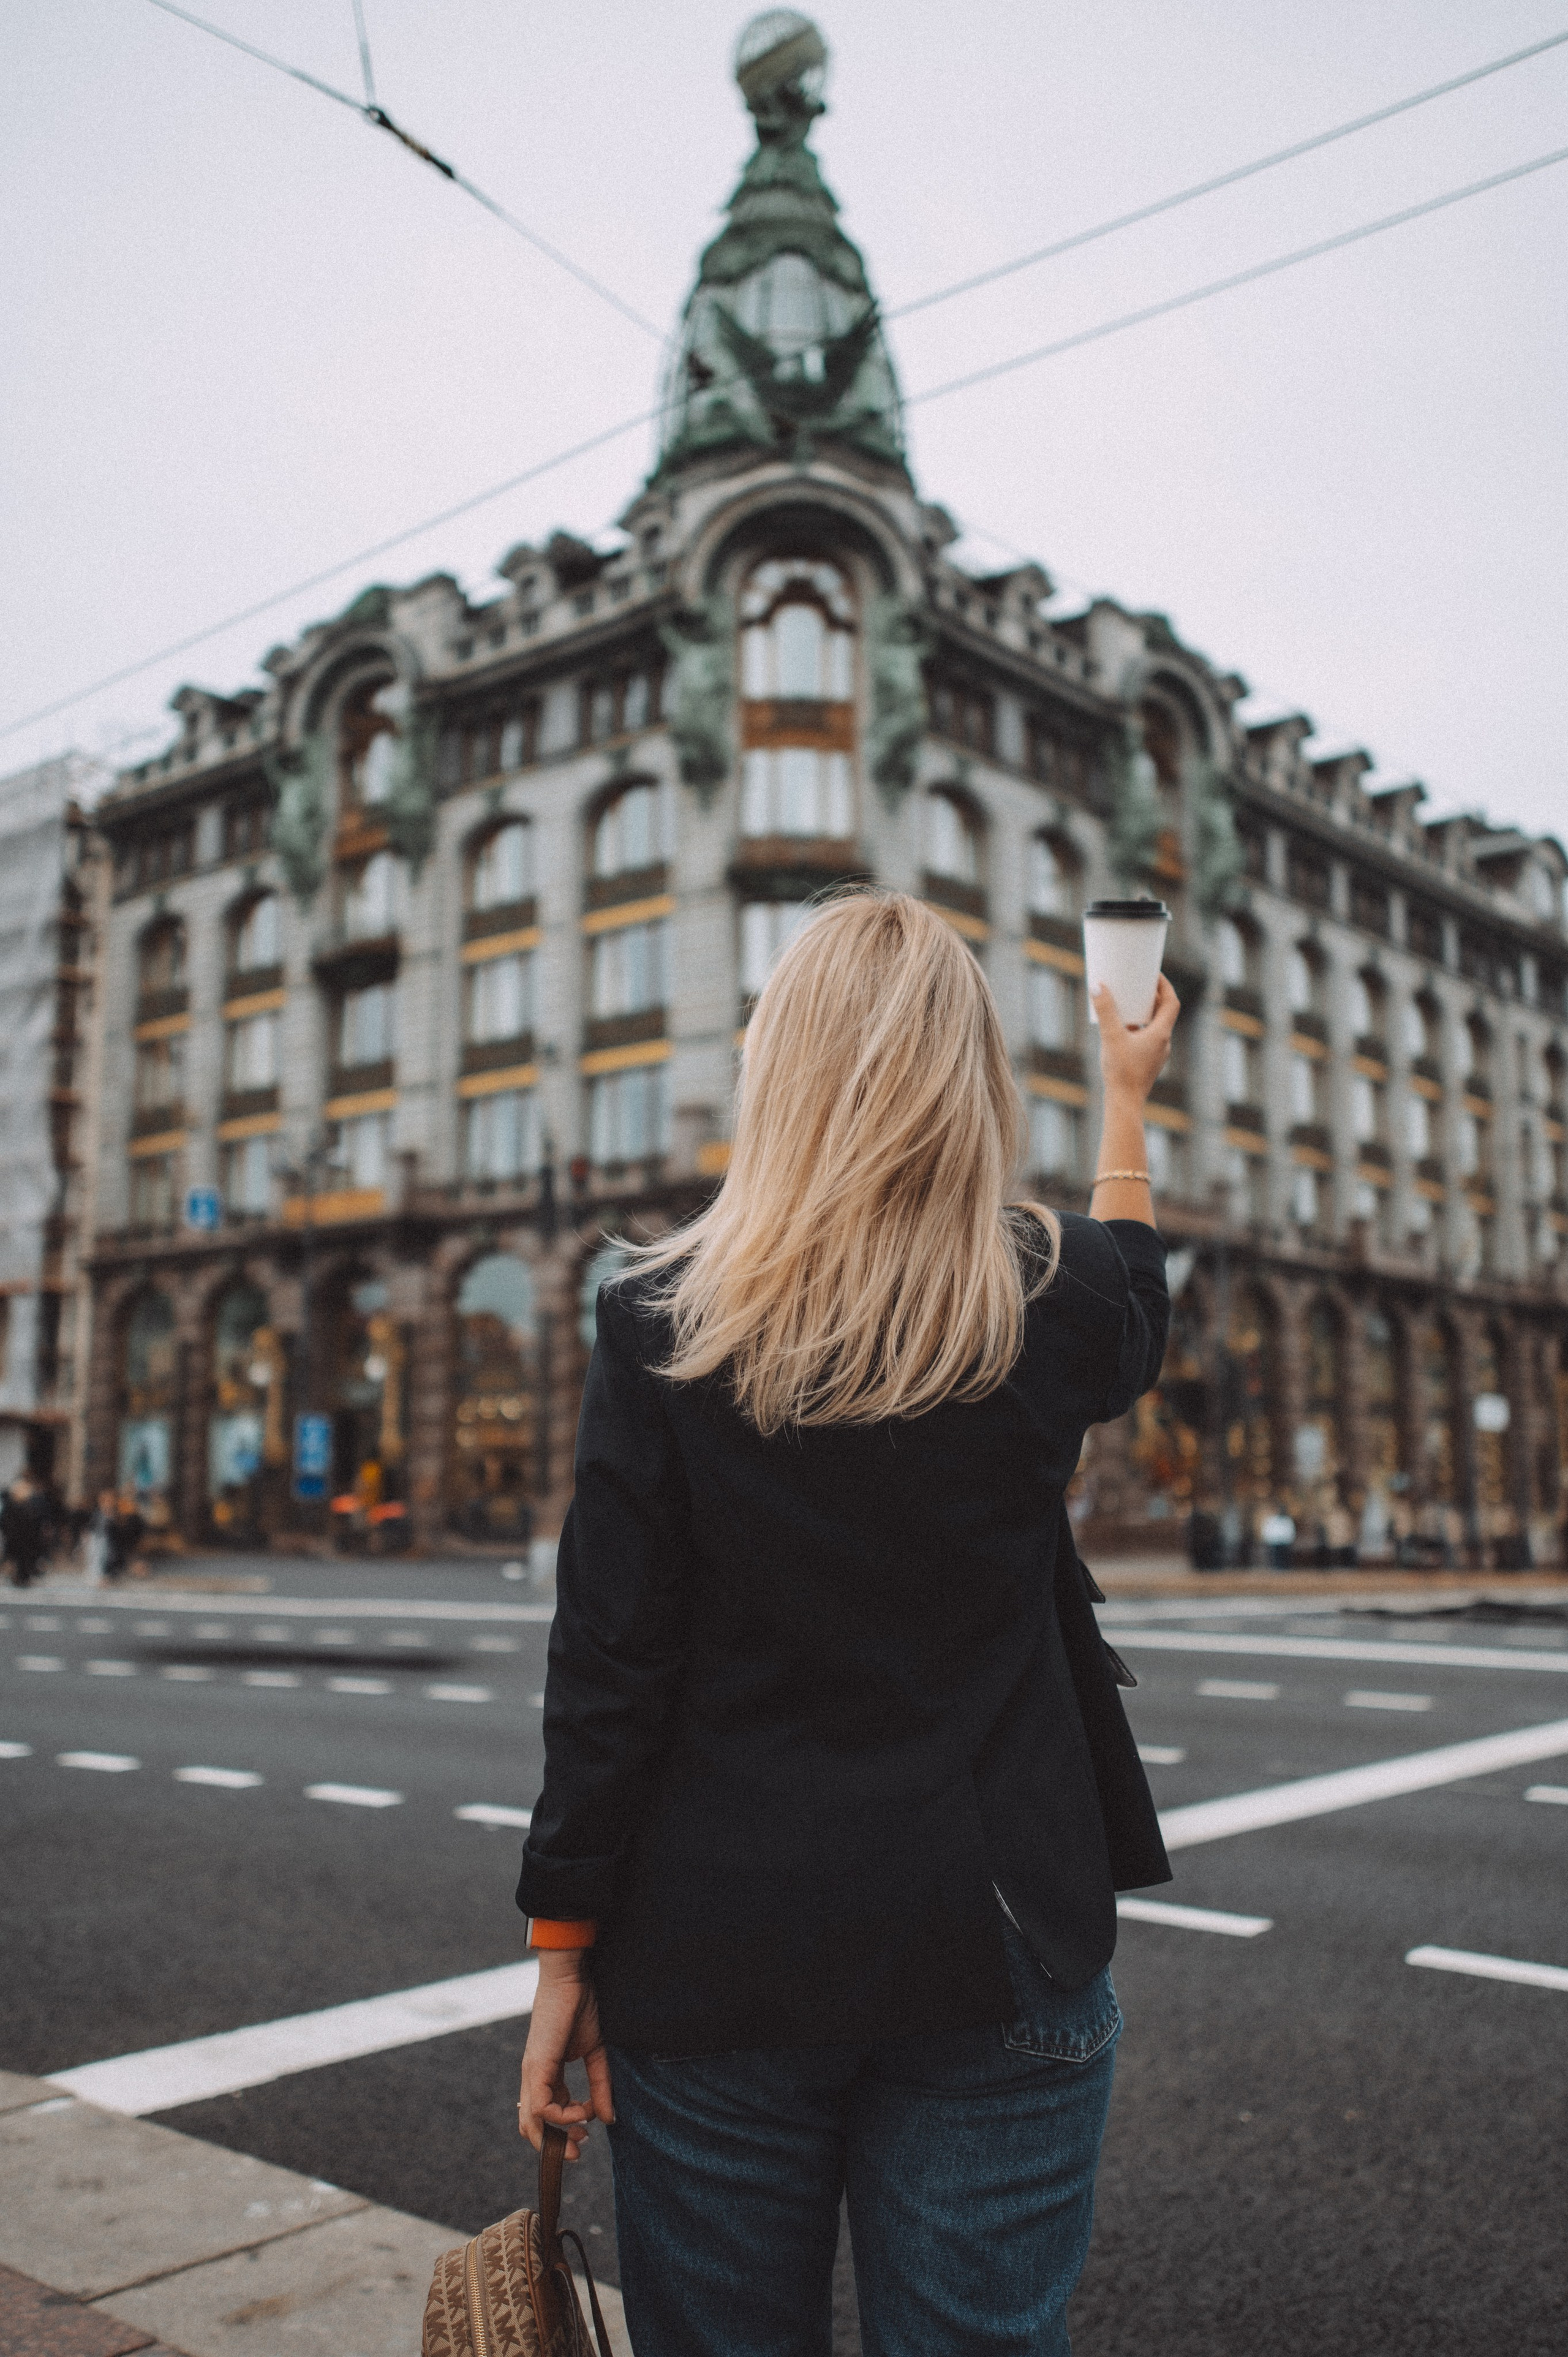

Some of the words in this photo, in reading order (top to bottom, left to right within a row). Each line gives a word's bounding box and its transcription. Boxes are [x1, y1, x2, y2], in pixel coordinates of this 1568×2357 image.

[484, 2243, 505, 2279] MK
[489, 2274, 510, 2316] MK
[426, 2309, 450, 2351] MK
[494, 2309, 521, 2356] MK
